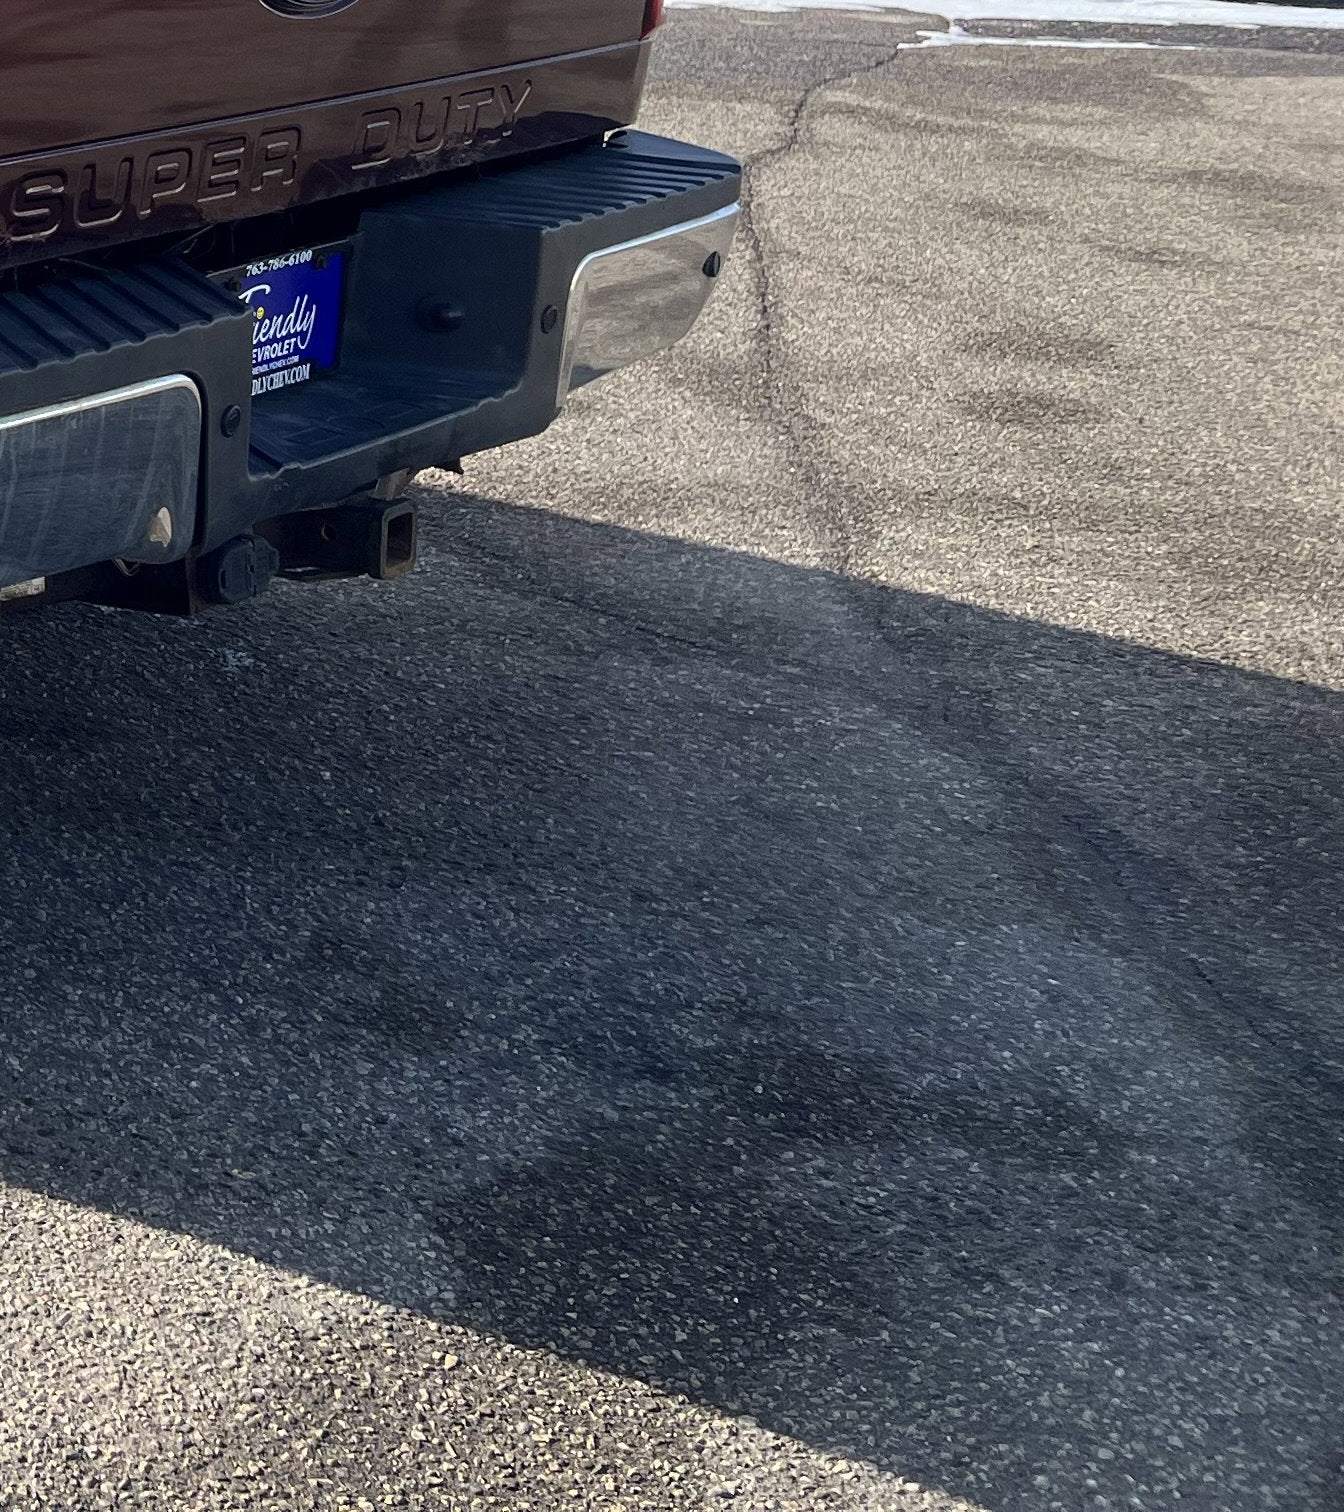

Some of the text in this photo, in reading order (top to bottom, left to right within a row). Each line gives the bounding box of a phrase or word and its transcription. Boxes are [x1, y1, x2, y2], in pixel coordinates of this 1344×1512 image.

[10, 78, 533, 242] SUPER DUTY
[246, 250, 313, 277] 763-786-6100
[252, 338, 297, 363] EVROLET
[251, 363, 311, 396] DLYCHEV.COM
